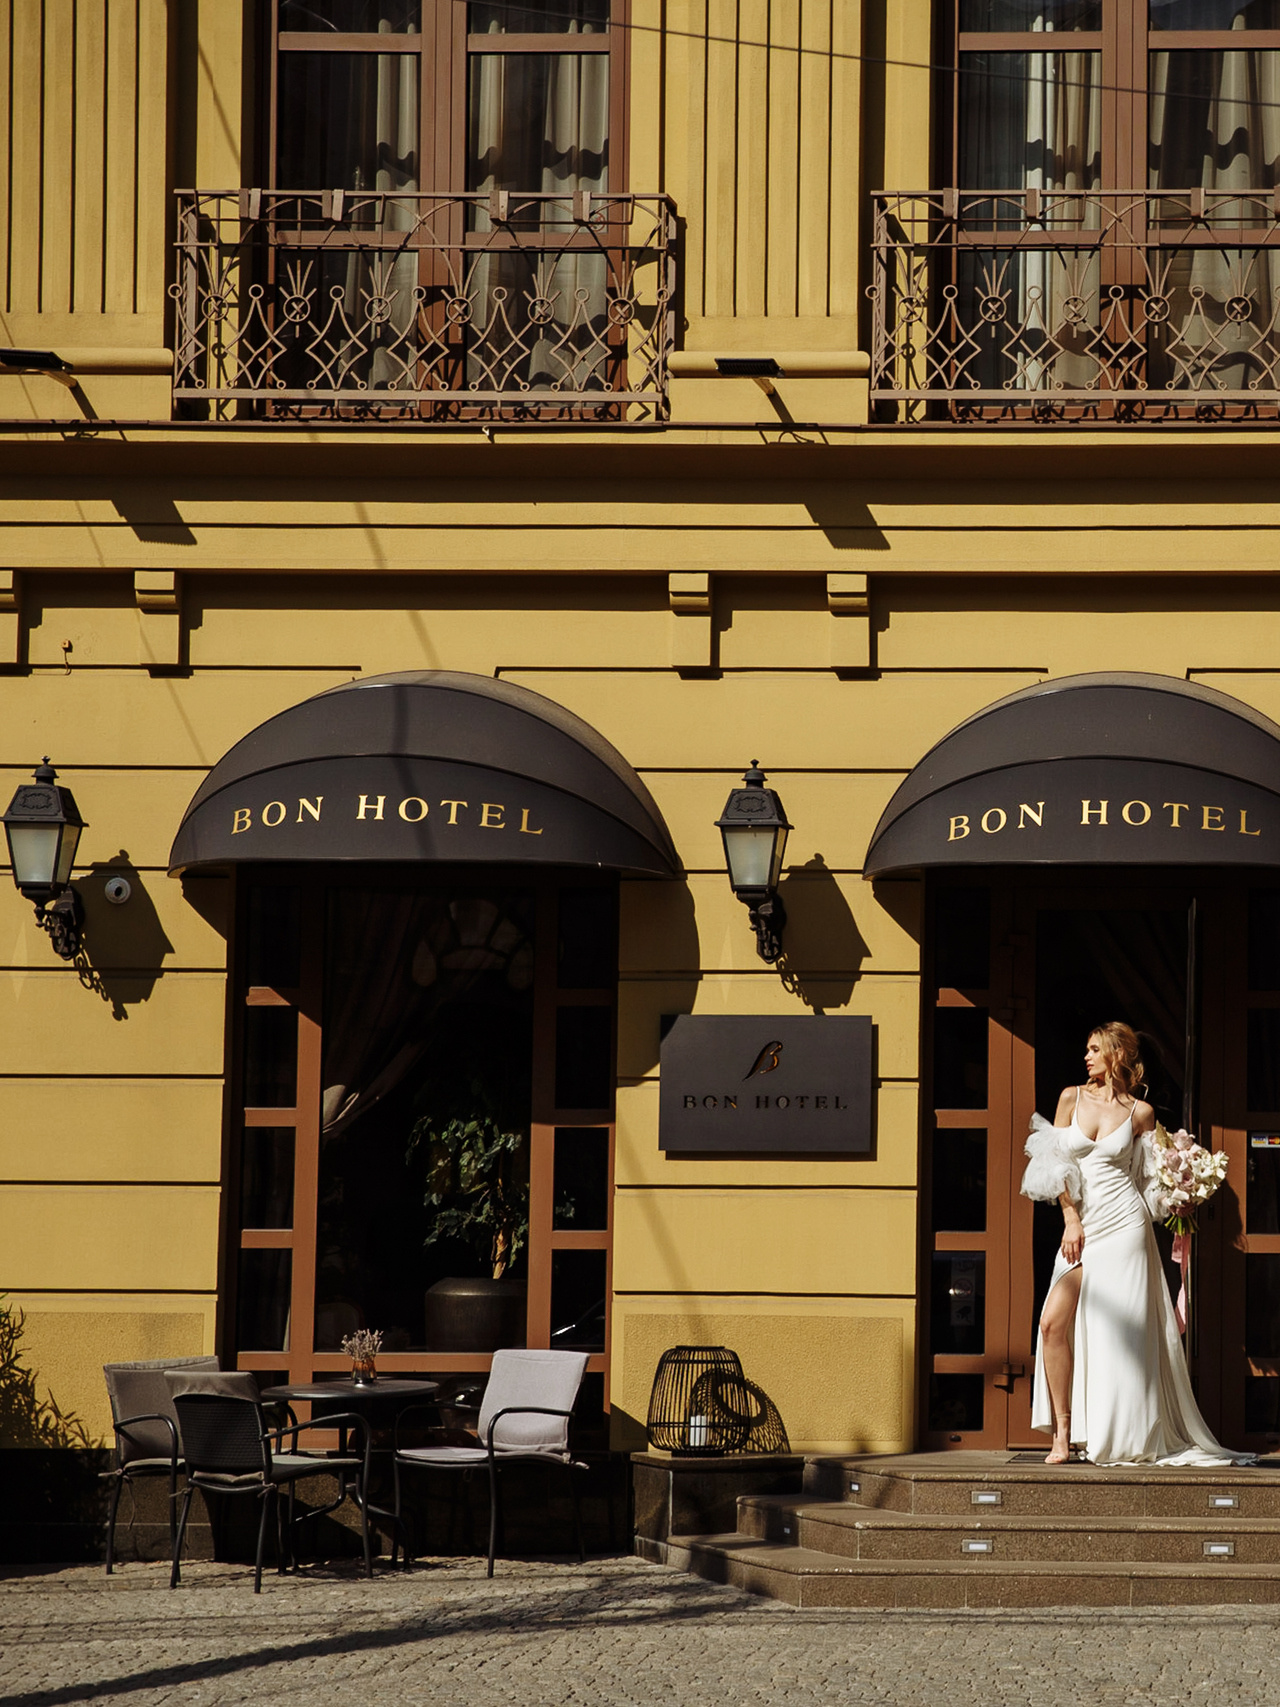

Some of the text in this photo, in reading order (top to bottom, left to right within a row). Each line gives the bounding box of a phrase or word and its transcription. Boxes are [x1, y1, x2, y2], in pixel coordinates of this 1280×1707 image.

[231, 794, 544, 835] BON HOTEL
[947, 799, 1262, 841] BON HOTEL
[682, 1095, 848, 1109] BON HOTEL
